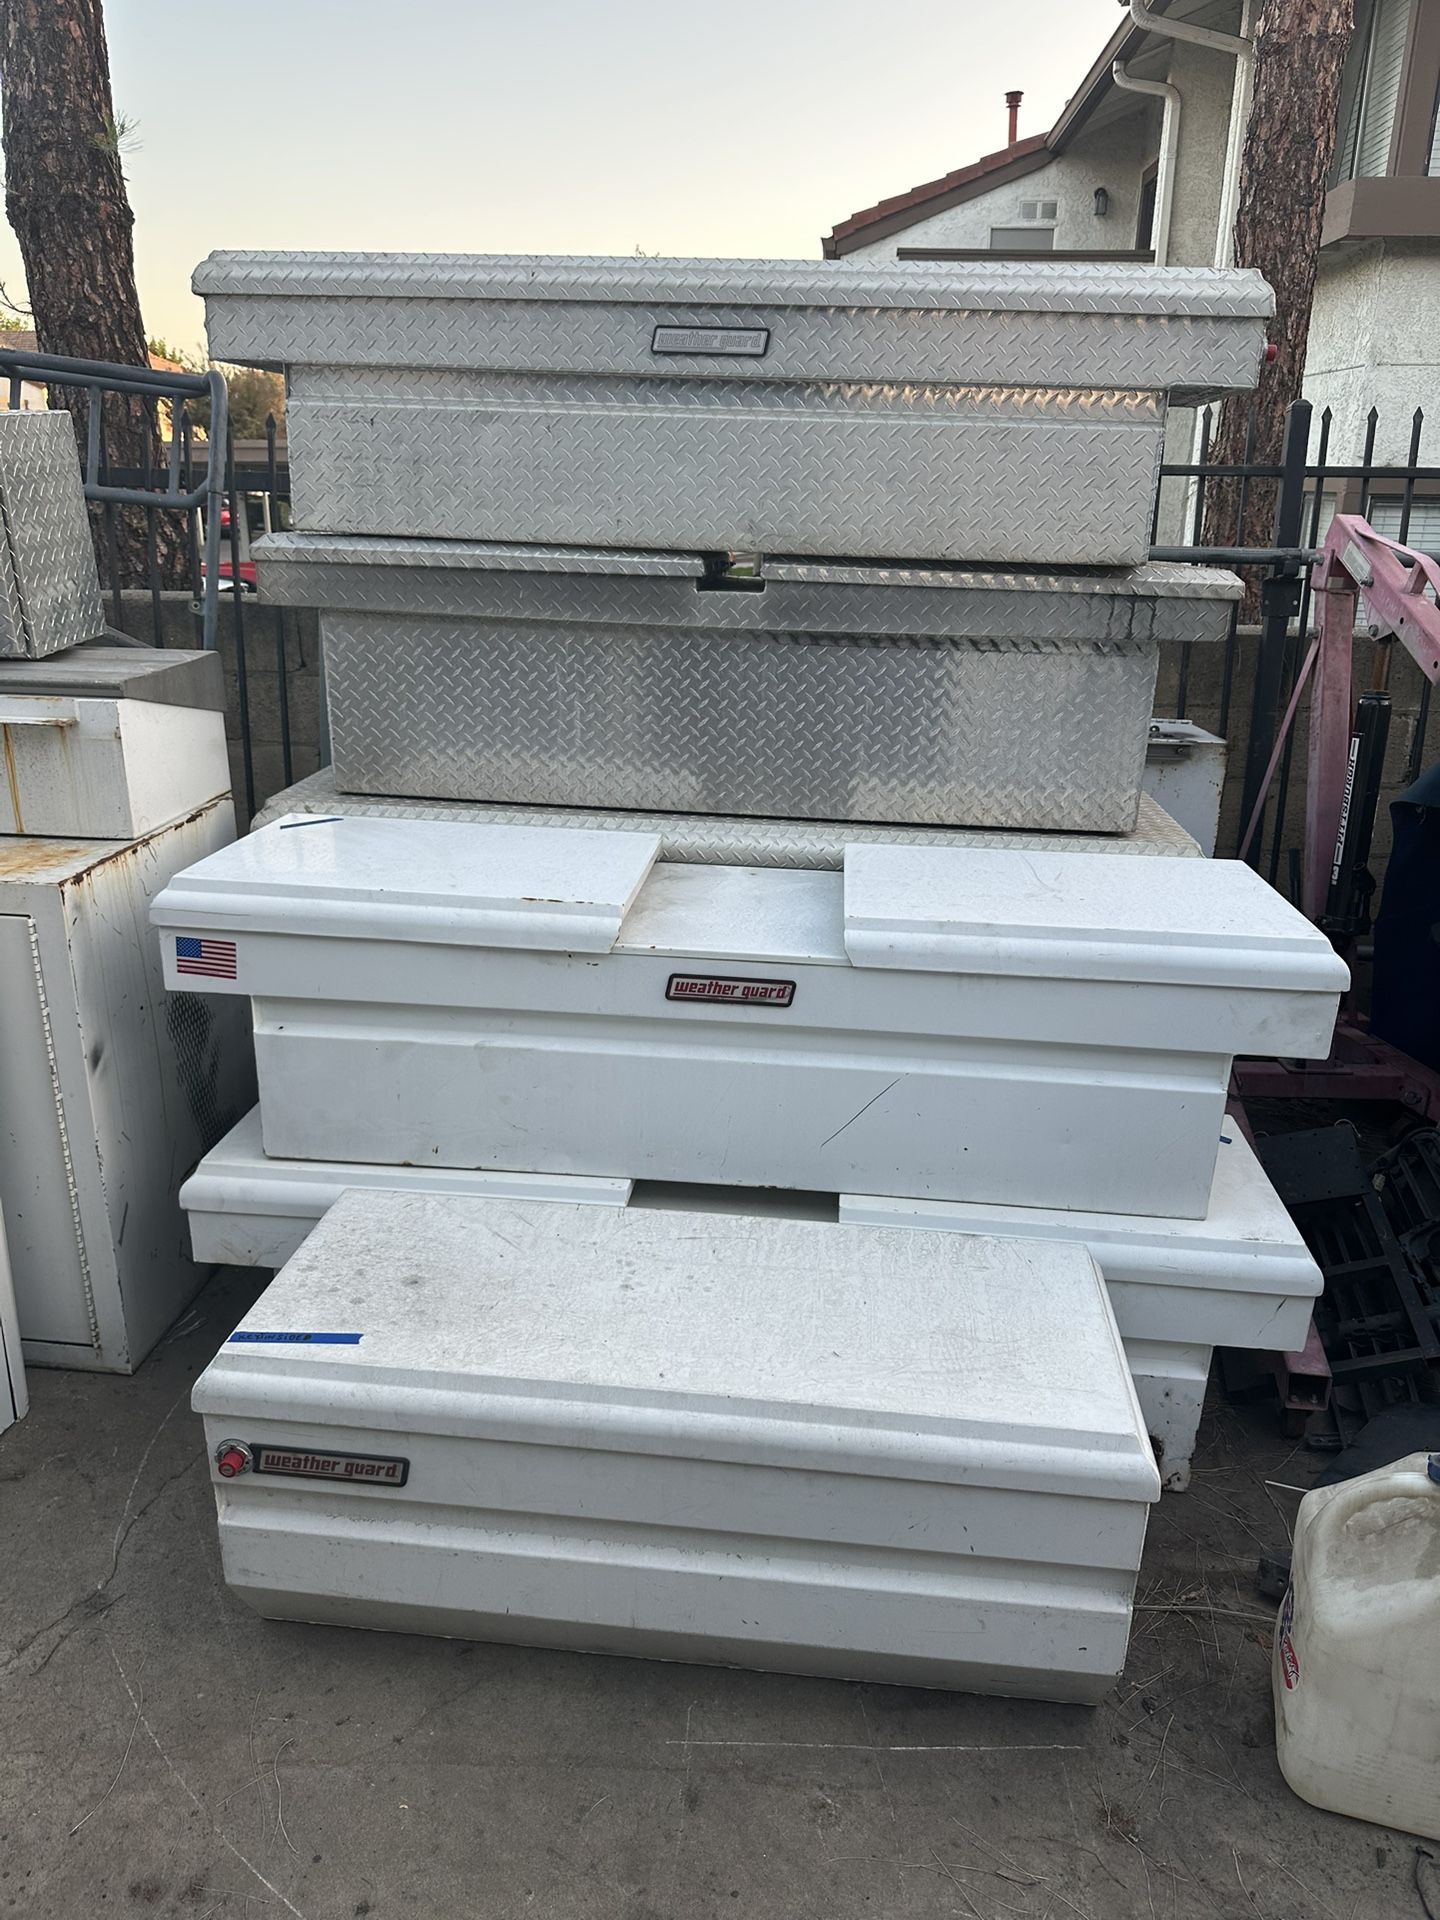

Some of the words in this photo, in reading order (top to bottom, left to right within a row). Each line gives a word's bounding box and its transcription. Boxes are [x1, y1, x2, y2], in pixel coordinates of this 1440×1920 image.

[659, 331, 719, 346] weather
[719, 331, 762, 351] guard
[1336, 758, 1357, 846] PITTSBURGH
[674, 981, 740, 996] weather
[741, 985, 788, 1000] guard
[264, 1453, 341, 1472] weather
[343, 1461, 399, 1479] guard
